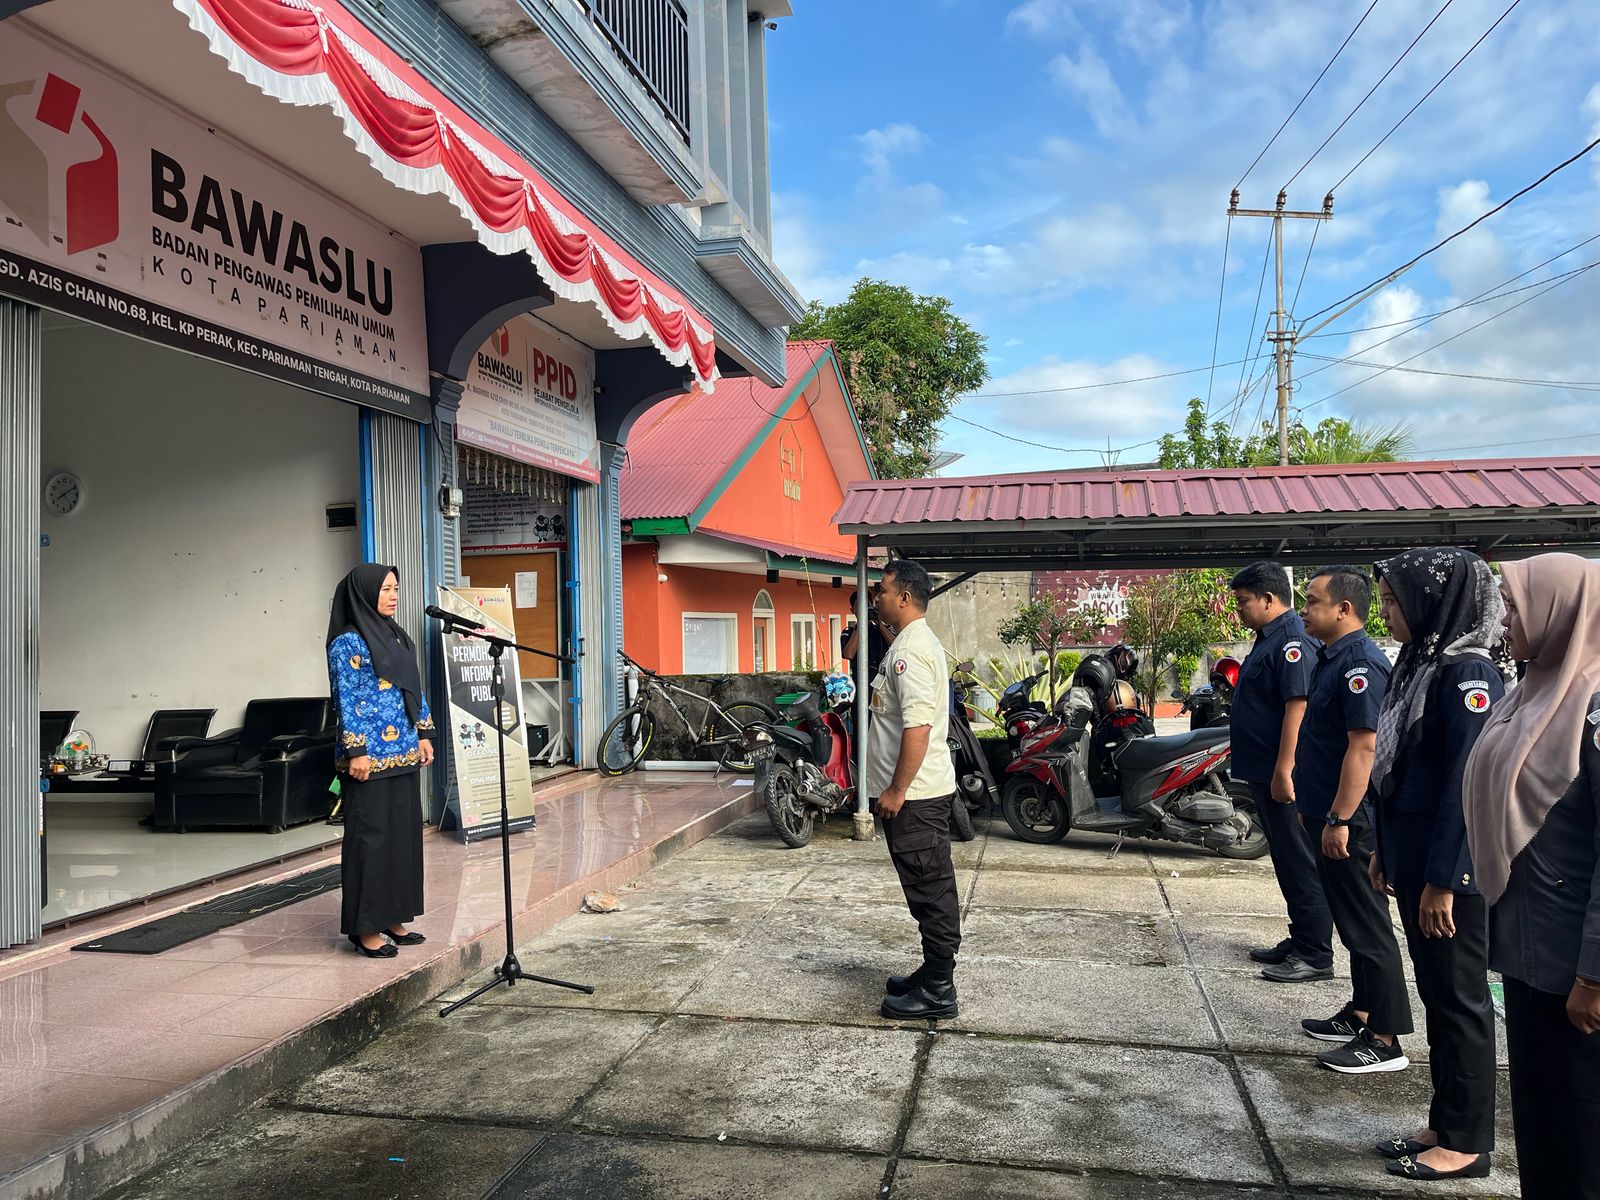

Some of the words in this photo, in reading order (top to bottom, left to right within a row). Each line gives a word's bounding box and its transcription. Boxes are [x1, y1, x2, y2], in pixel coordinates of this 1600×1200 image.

[151, 147, 393, 316] BAWASLU
[152, 226, 209, 266] BADAN
[214, 252, 292, 300] PENGAWAS
[296, 287, 359, 327] PEMILIHAN
[362, 315, 395, 342] UMUM
[153, 255, 241, 305] KOTA
[28, 269, 62, 292] AZIS
[65, 282, 106, 307] CHAN
[108, 298, 149, 326] NO.68,
[152, 311, 178, 332] KEL.
[179, 320, 195, 336] KP
[197, 326, 236, 352] PERAK,
[237, 340, 261, 358] KEC.
[262, 348, 312, 375] PARIAMAN
[313, 365, 350, 388] TENGAH,
[350, 376, 371, 393] KOTA
[372, 383, 410, 405] PARIAMAN
[478, 351, 522, 386] BAWASLU
[532, 347, 577, 401] PPID
[533, 387, 554, 404] PEJABAT
[554, 396, 580, 415] PENGELOLA
